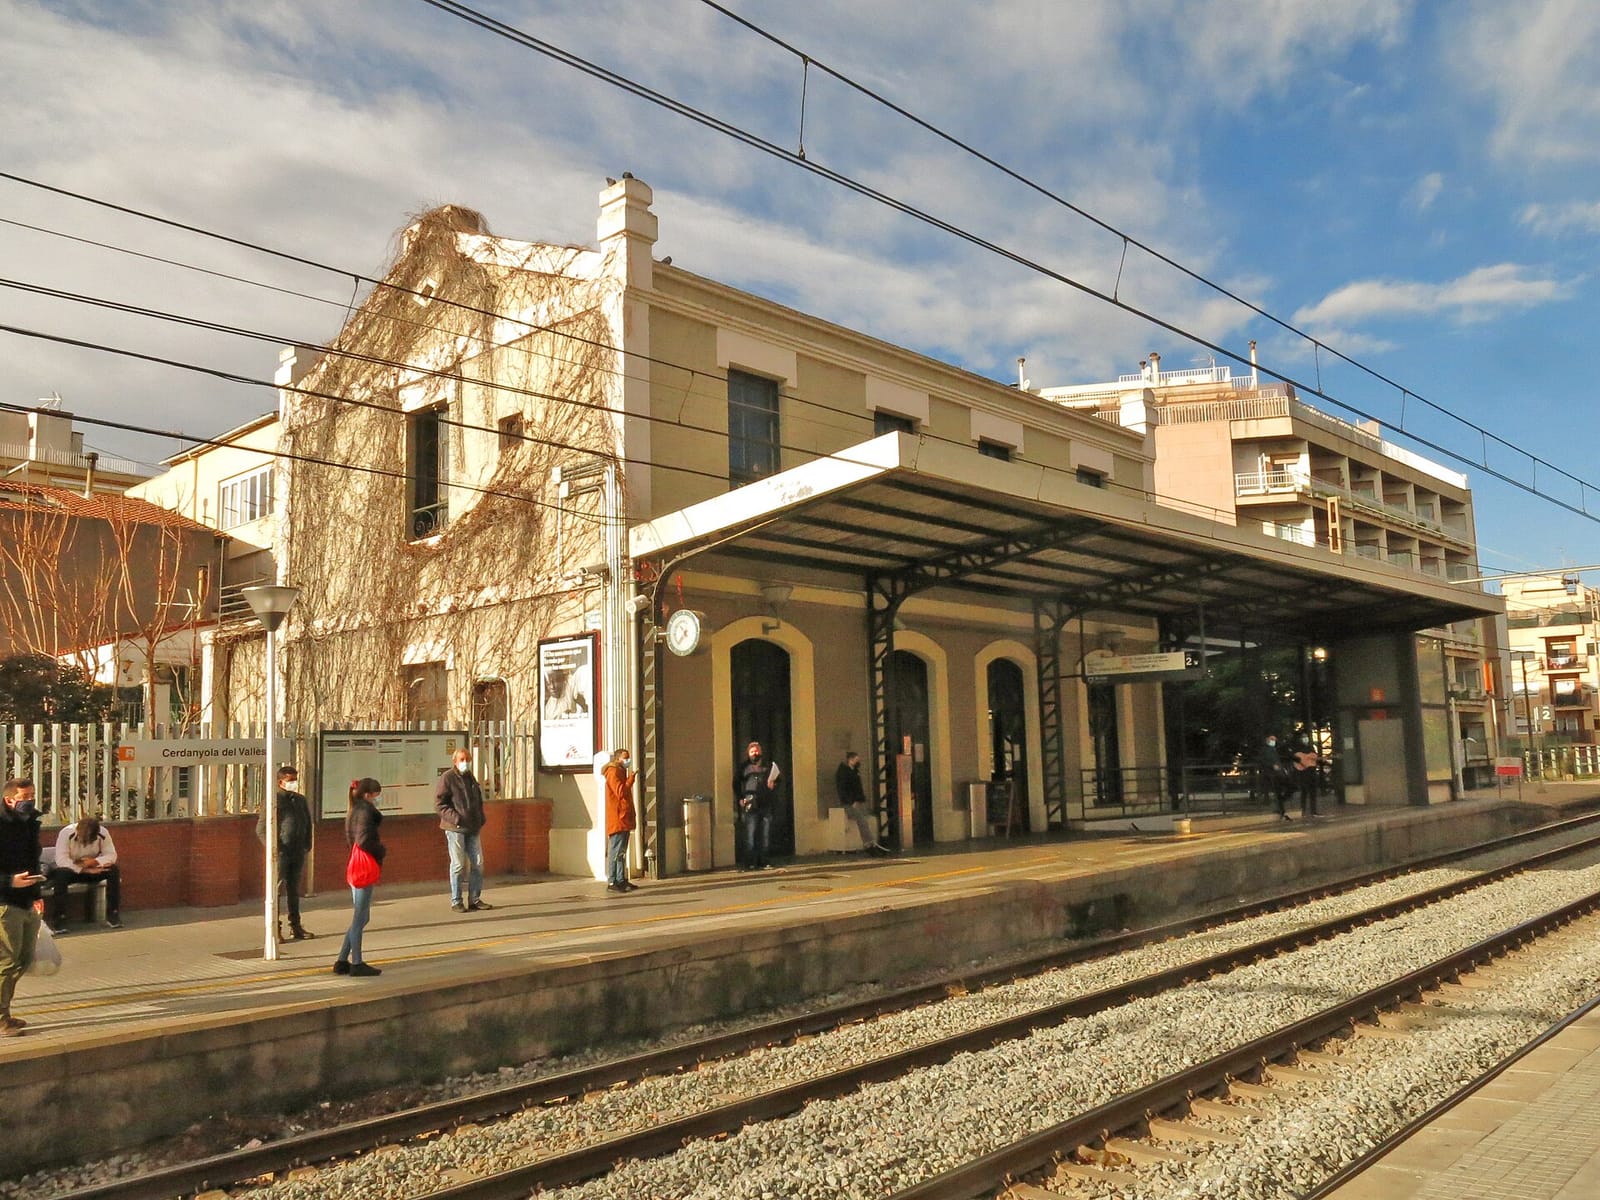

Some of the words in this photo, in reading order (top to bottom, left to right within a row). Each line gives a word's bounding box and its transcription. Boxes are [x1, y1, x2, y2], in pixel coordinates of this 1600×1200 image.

[1185, 657, 1193, 666] 2
[1542, 710, 1551, 720] 2
[162, 748, 219, 759] Cerdanyola
[222, 747, 236, 757] del
